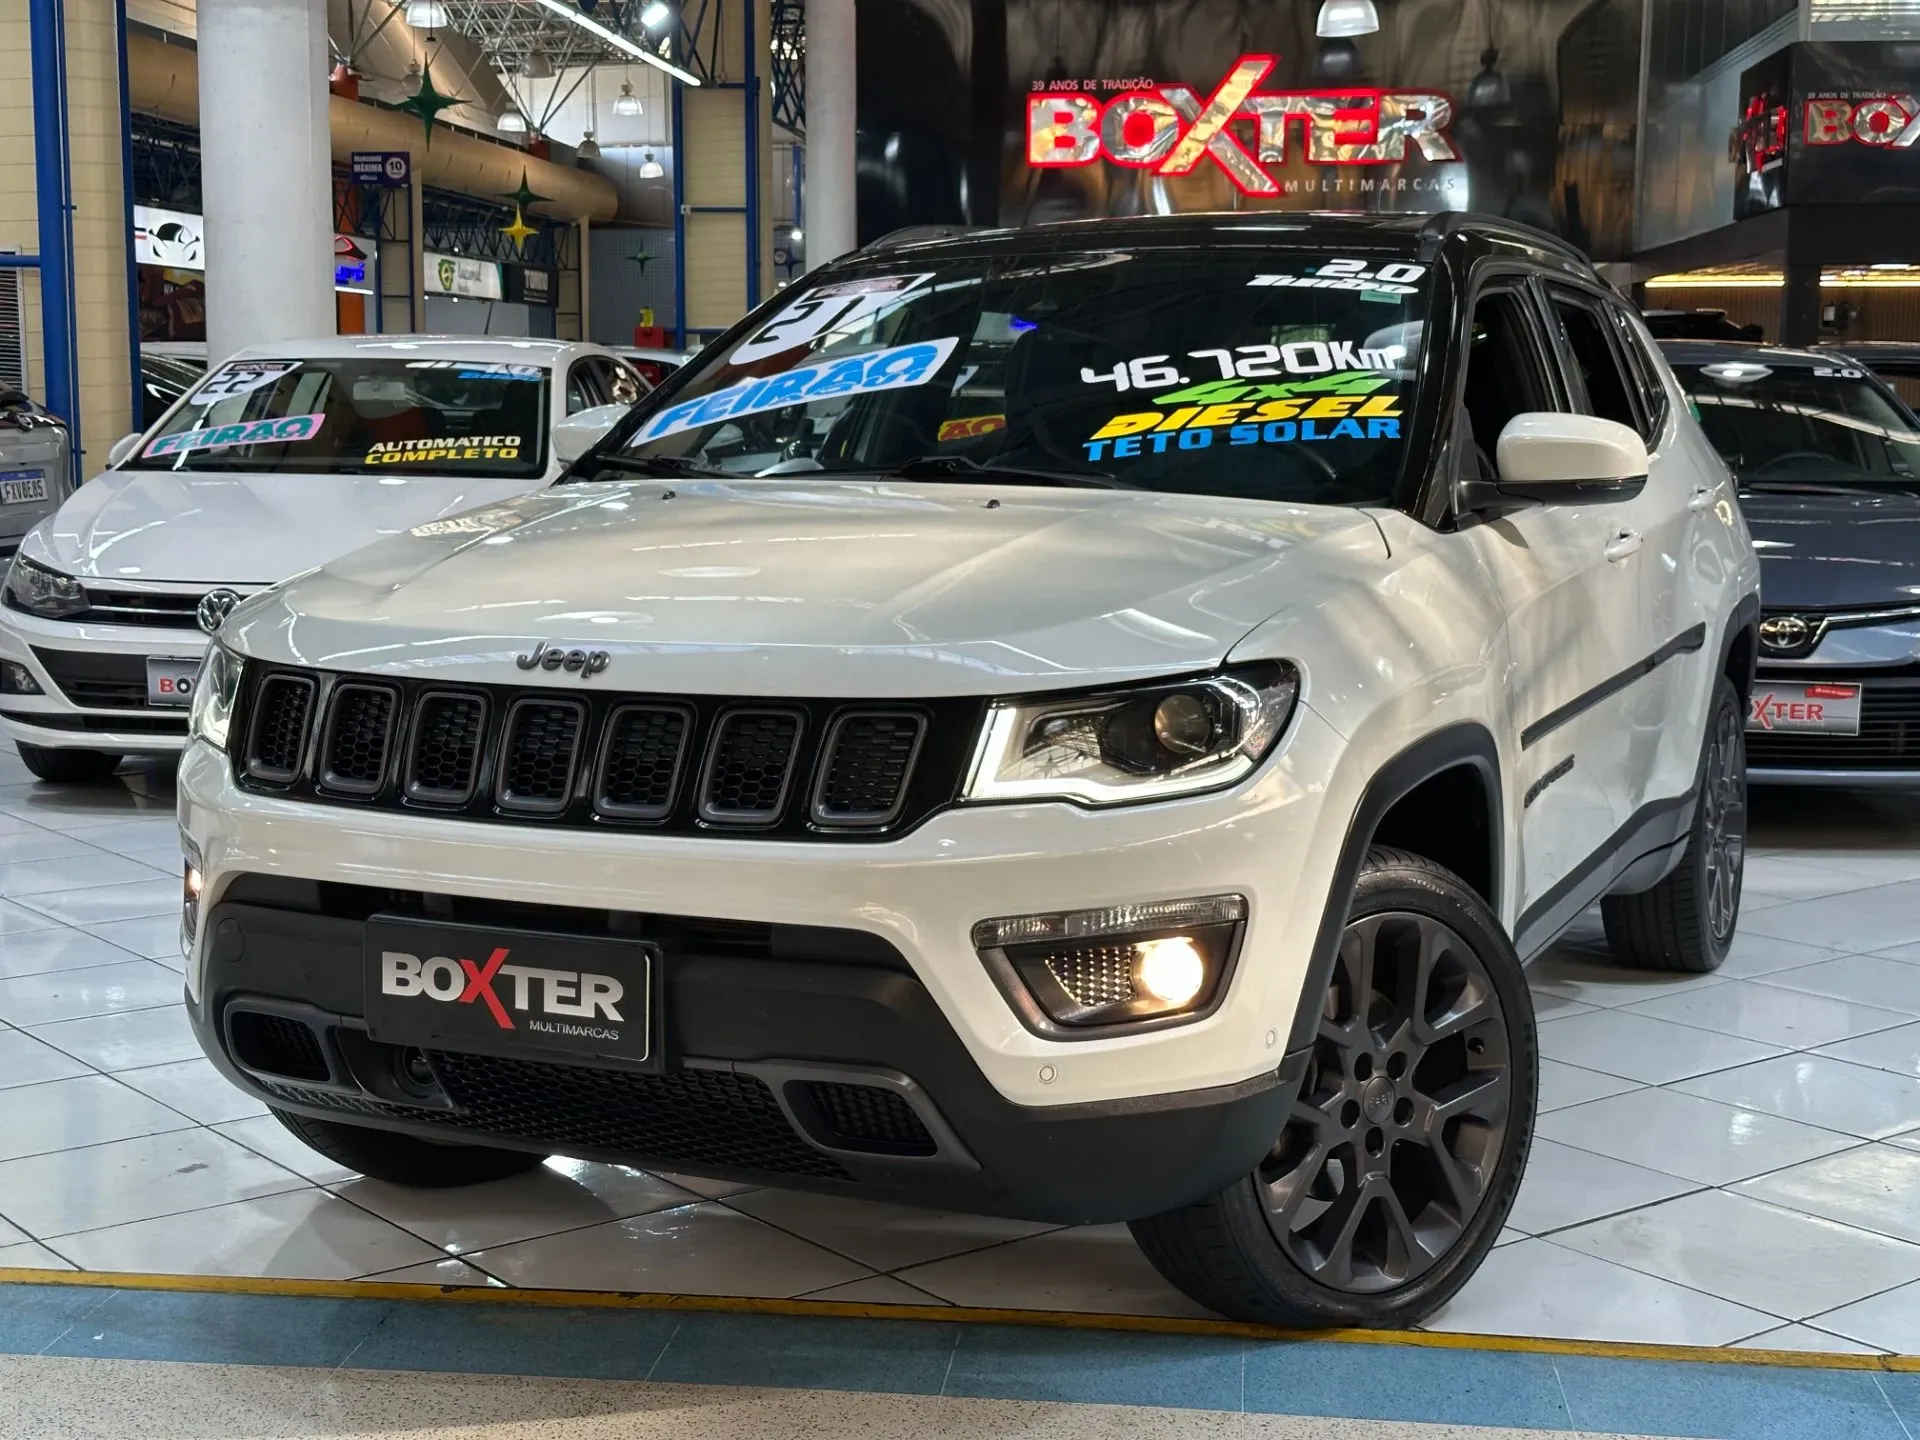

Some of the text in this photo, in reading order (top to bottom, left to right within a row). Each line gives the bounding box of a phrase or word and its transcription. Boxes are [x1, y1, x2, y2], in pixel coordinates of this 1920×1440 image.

[1031, 76, 1154, 92] 39 ANOS DE TRADIÇÃO
[1818, 91, 1838, 99] ANOS
[1840, 91, 1850, 99] DE
[1852, 89, 1887, 99] TRADIÇÃO
[1026, 53, 1463, 197] BOXTER
[389, 160, 402, 171] 10
[1284, 177, 1456, 193] MULTIMARCAS
[1314, 258, 1427, 284] 2.0
[199, 371, 265, 395] 22
[1813, 366, 1863, 379] 2.0
[646, 344, 939, 439] FEIRÃO
[1089, 395, 1404, 441] DIESEL
[151, 415, 314, 454] FEIRÃO
[368, 435, 522, 453] AUTOMATICO
[1081, 417, 1402, 463] TETO SOLAR
[364, 447, 519, 465] COMPLETO
[4, 479, 44, 501] FXV8E85
[516, 641, 611, 679] Jeep
[158, 676, 197, 694] BO
[381, 947, 625, 1030] BOXTER
[529, 1019, 620, 1041] MULTIMARCAS
